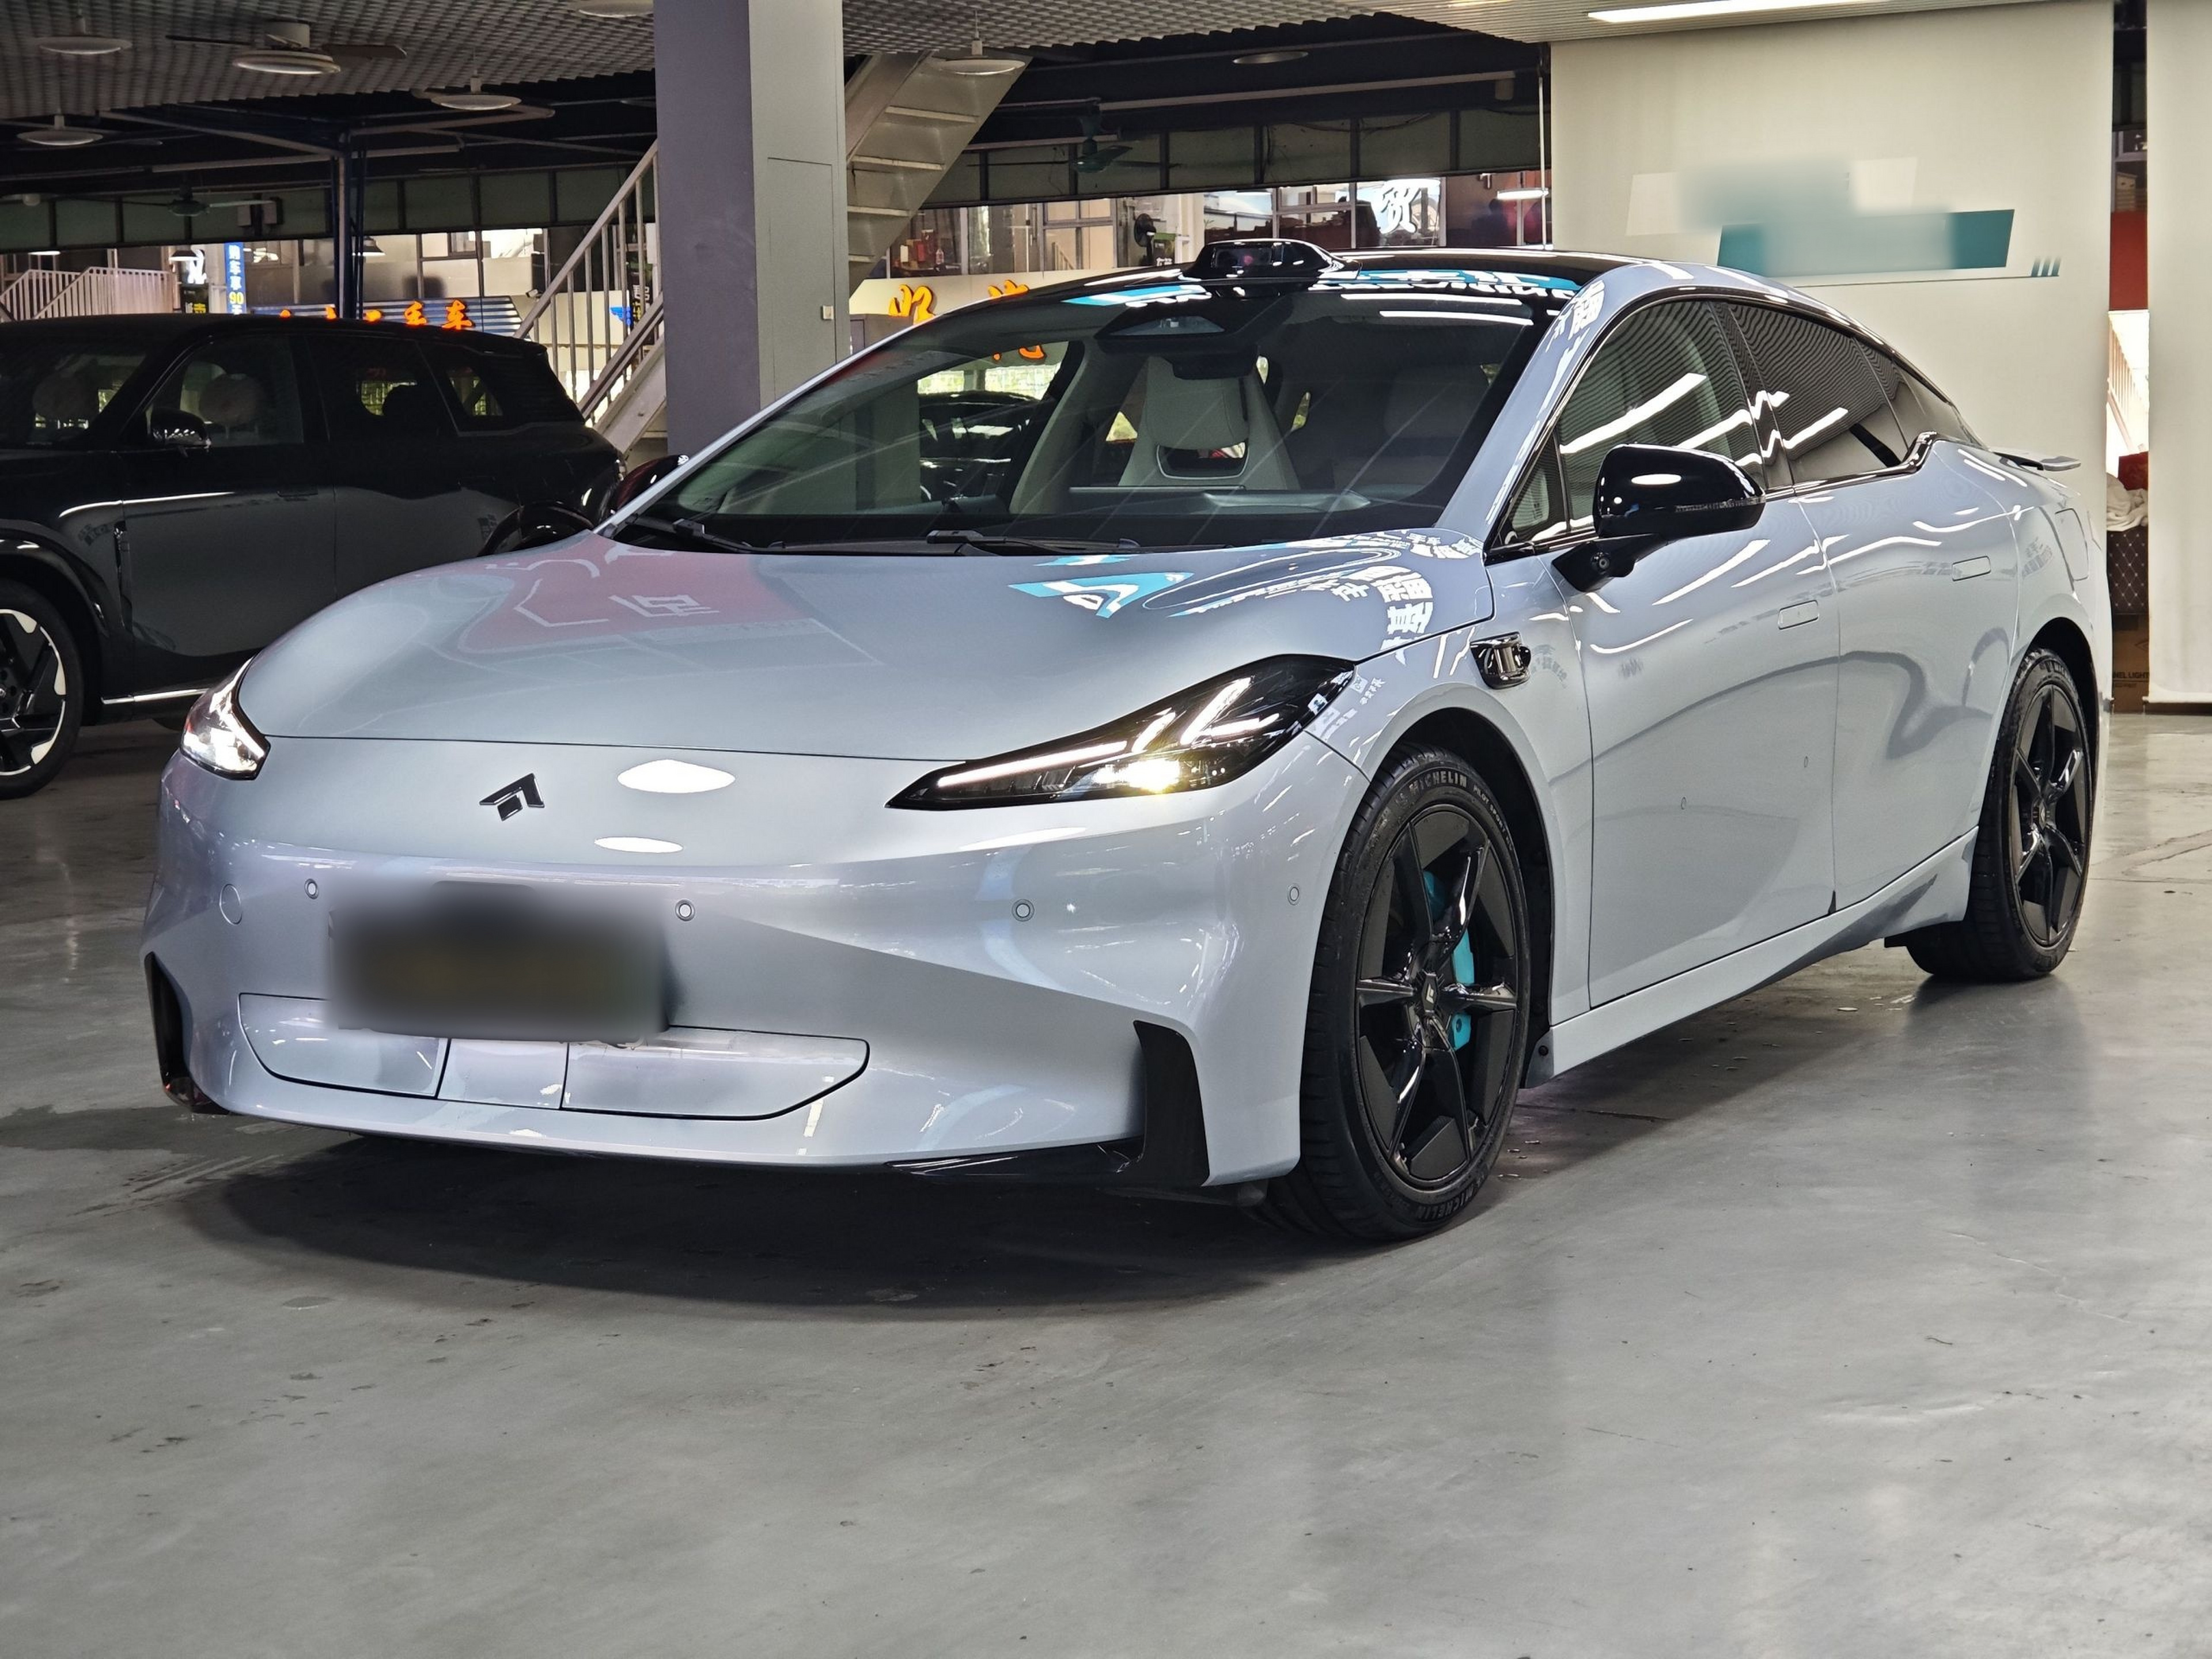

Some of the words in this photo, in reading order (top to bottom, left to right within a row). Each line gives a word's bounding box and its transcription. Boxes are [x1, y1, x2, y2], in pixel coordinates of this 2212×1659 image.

[1409, 771, 1467, 796] MICHELIN
[1473, 785, 1489, 804] PILOT
[1416, 1184, 1475, 1219] MICHELIN
